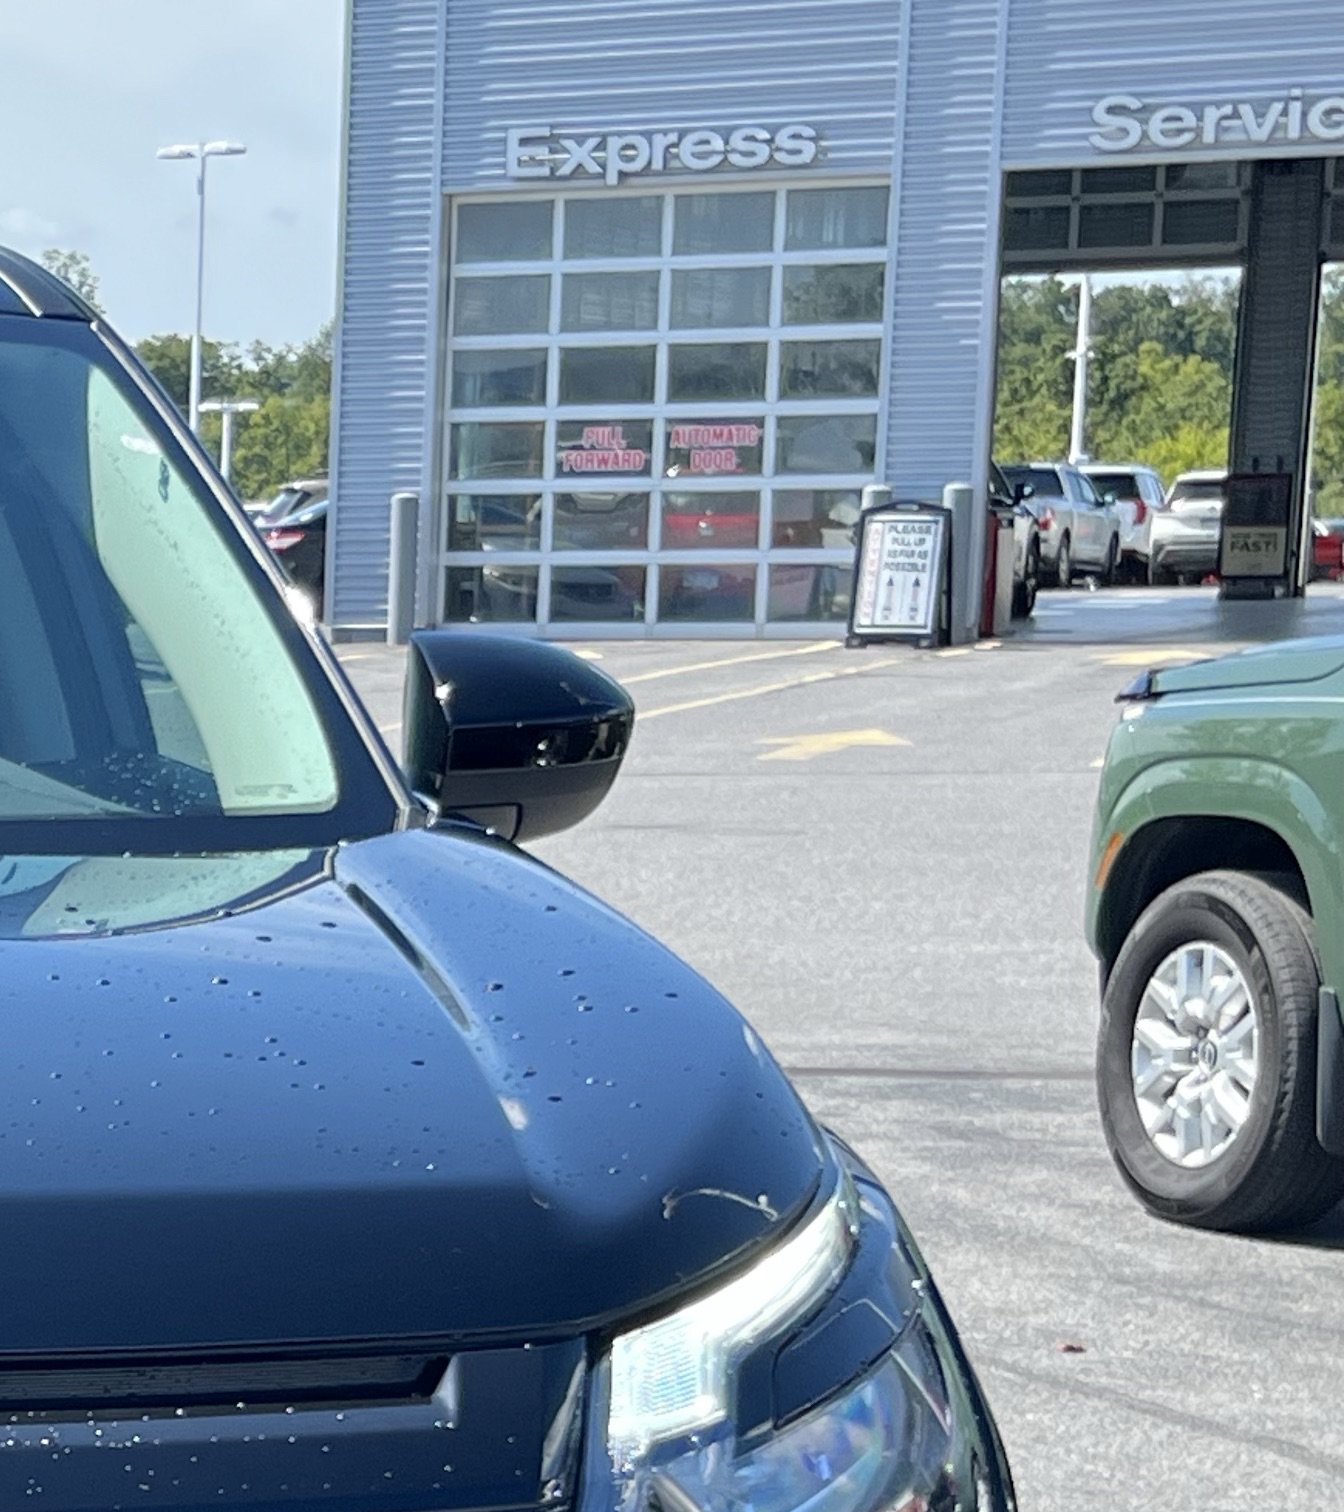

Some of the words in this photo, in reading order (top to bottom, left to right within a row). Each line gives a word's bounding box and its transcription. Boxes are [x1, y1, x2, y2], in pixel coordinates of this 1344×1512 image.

[507, 125, 817, 186] Express
[583, 427, 626, 448] PULL
[670, 424, 759, 447] AUTOMATIC
[562, 451, 647, 471] FORWARD
[691, 450, 736, 471] DOOR
[888, 525, 931, 534] PLEASE
[913, 537, 926, 546] UP
[1230, 540, 1278, 552] FAST!
